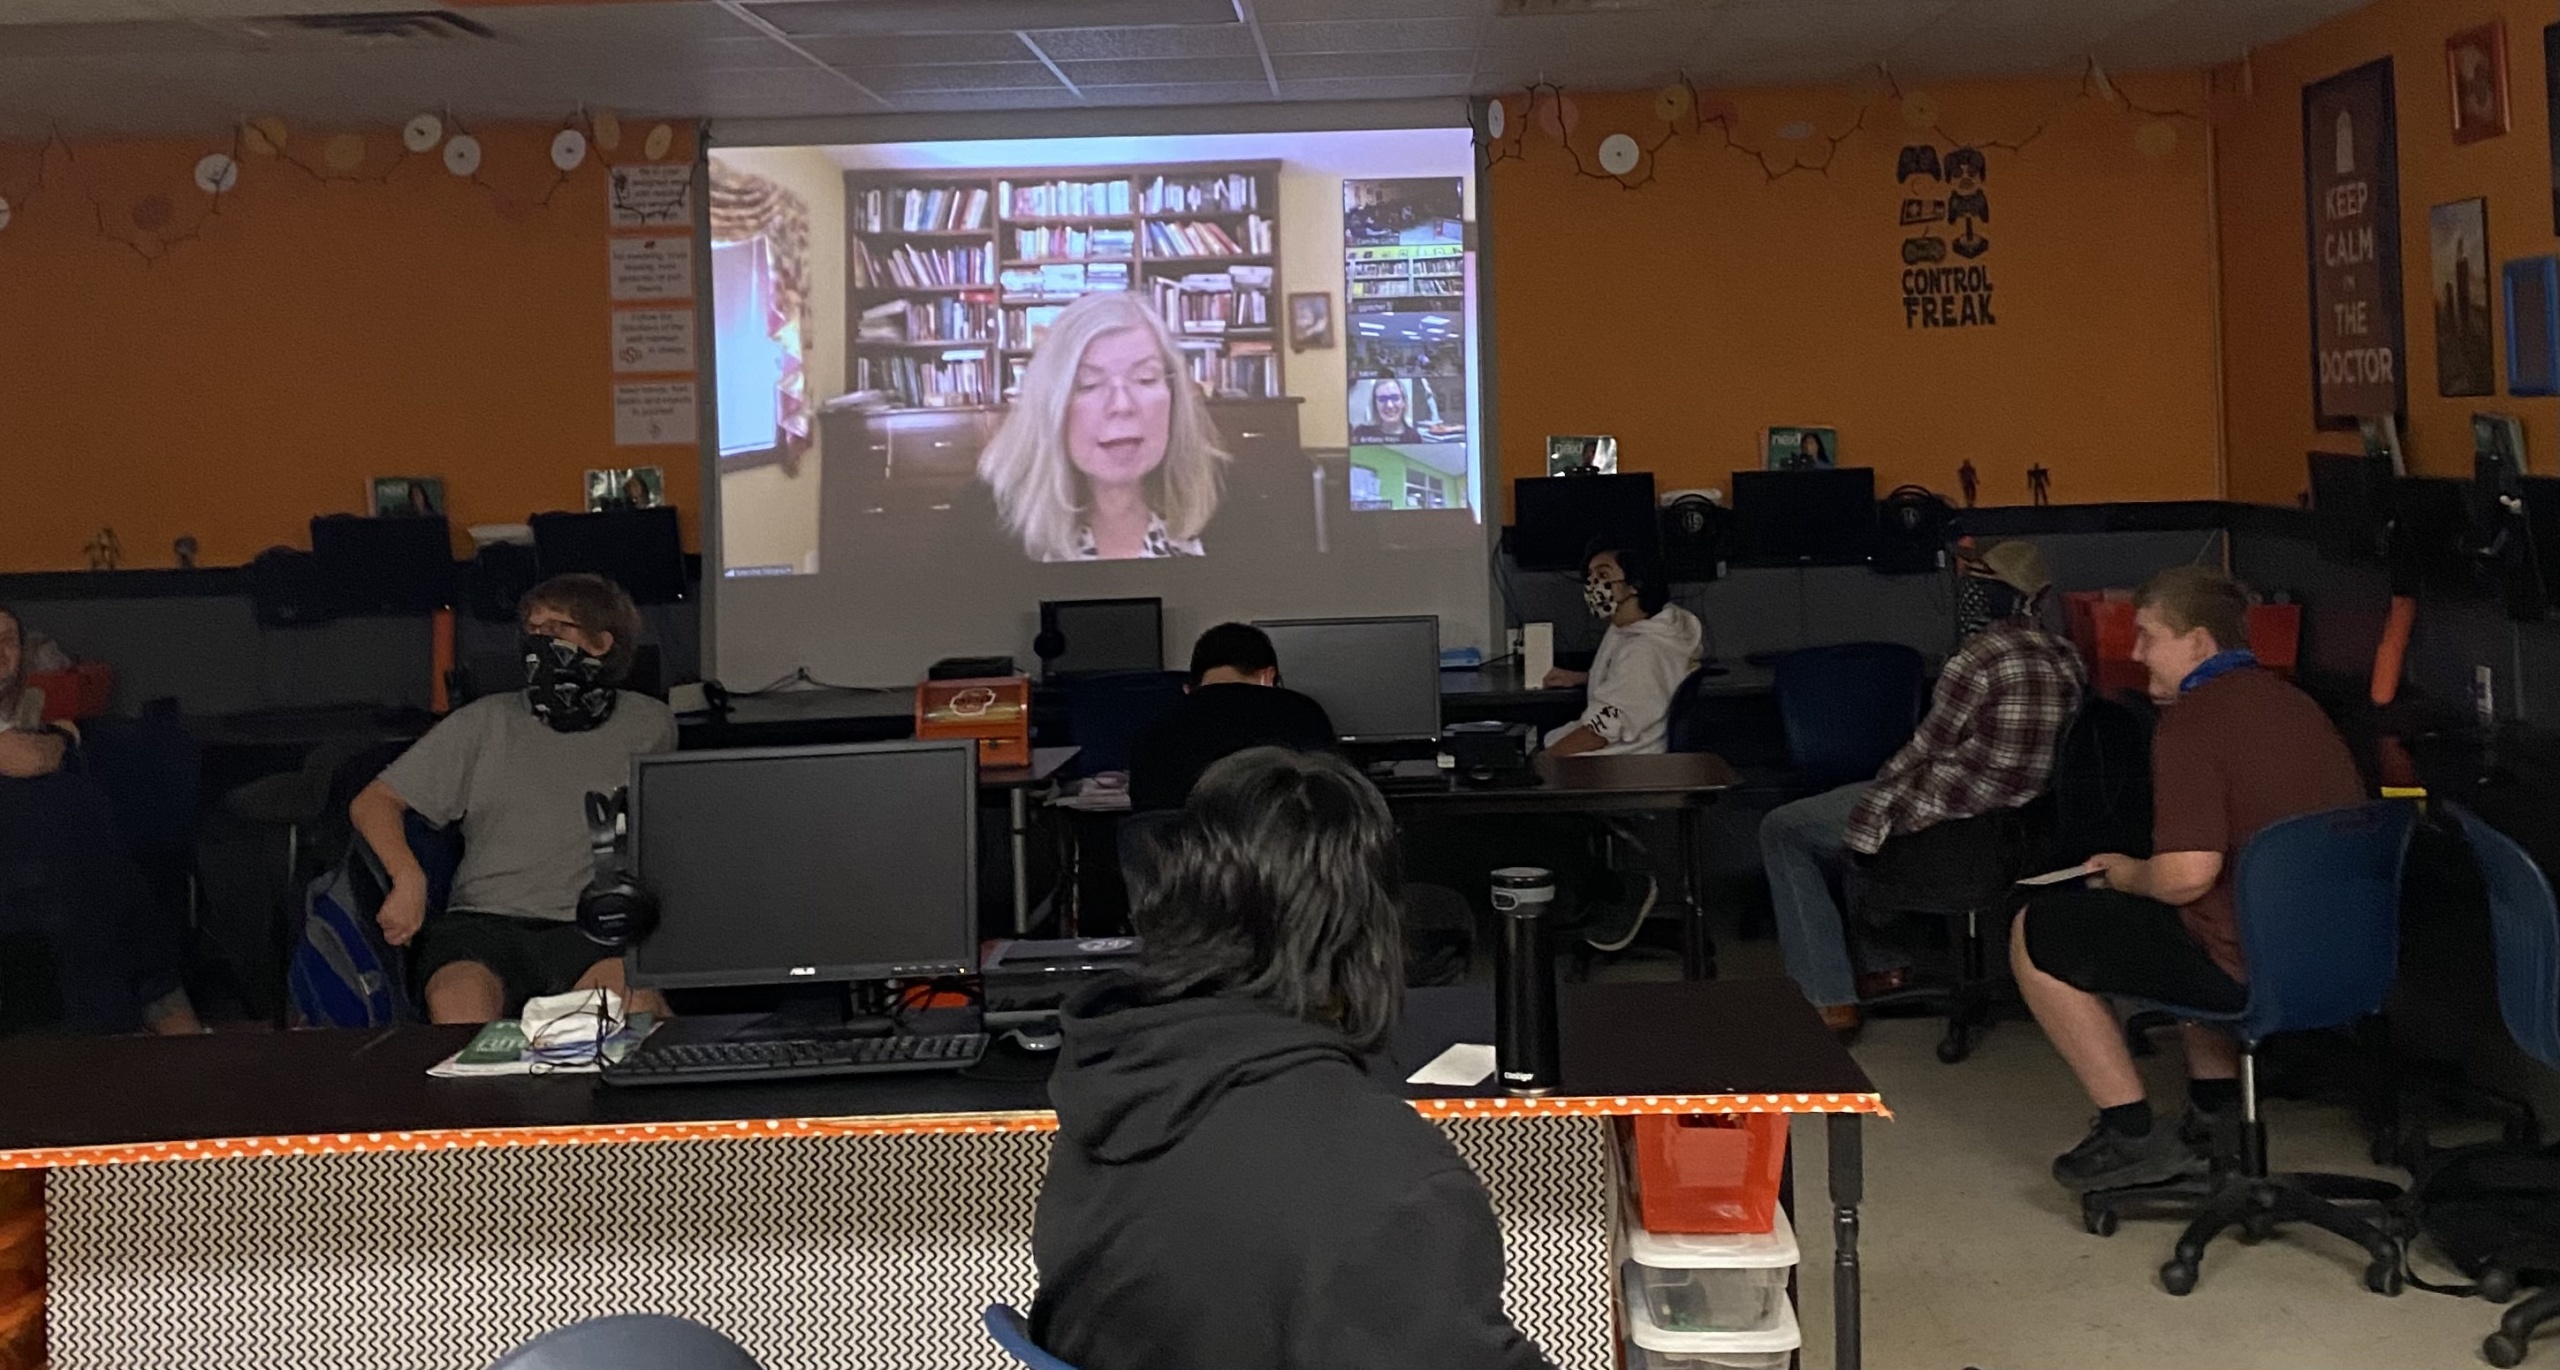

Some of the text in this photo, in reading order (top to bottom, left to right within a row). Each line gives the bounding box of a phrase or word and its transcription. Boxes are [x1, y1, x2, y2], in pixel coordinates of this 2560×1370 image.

[2325, 181, 2369, 222] KEEP
[2324, 226, 2374, 268] CALM
[1902, 265, 1994, 296] CONTROL
[1903, 293, 1997, 329] FREAK
[2333, 300, 2368, 335] THE
[2319, 347, 2394, 385] DOCTOR
